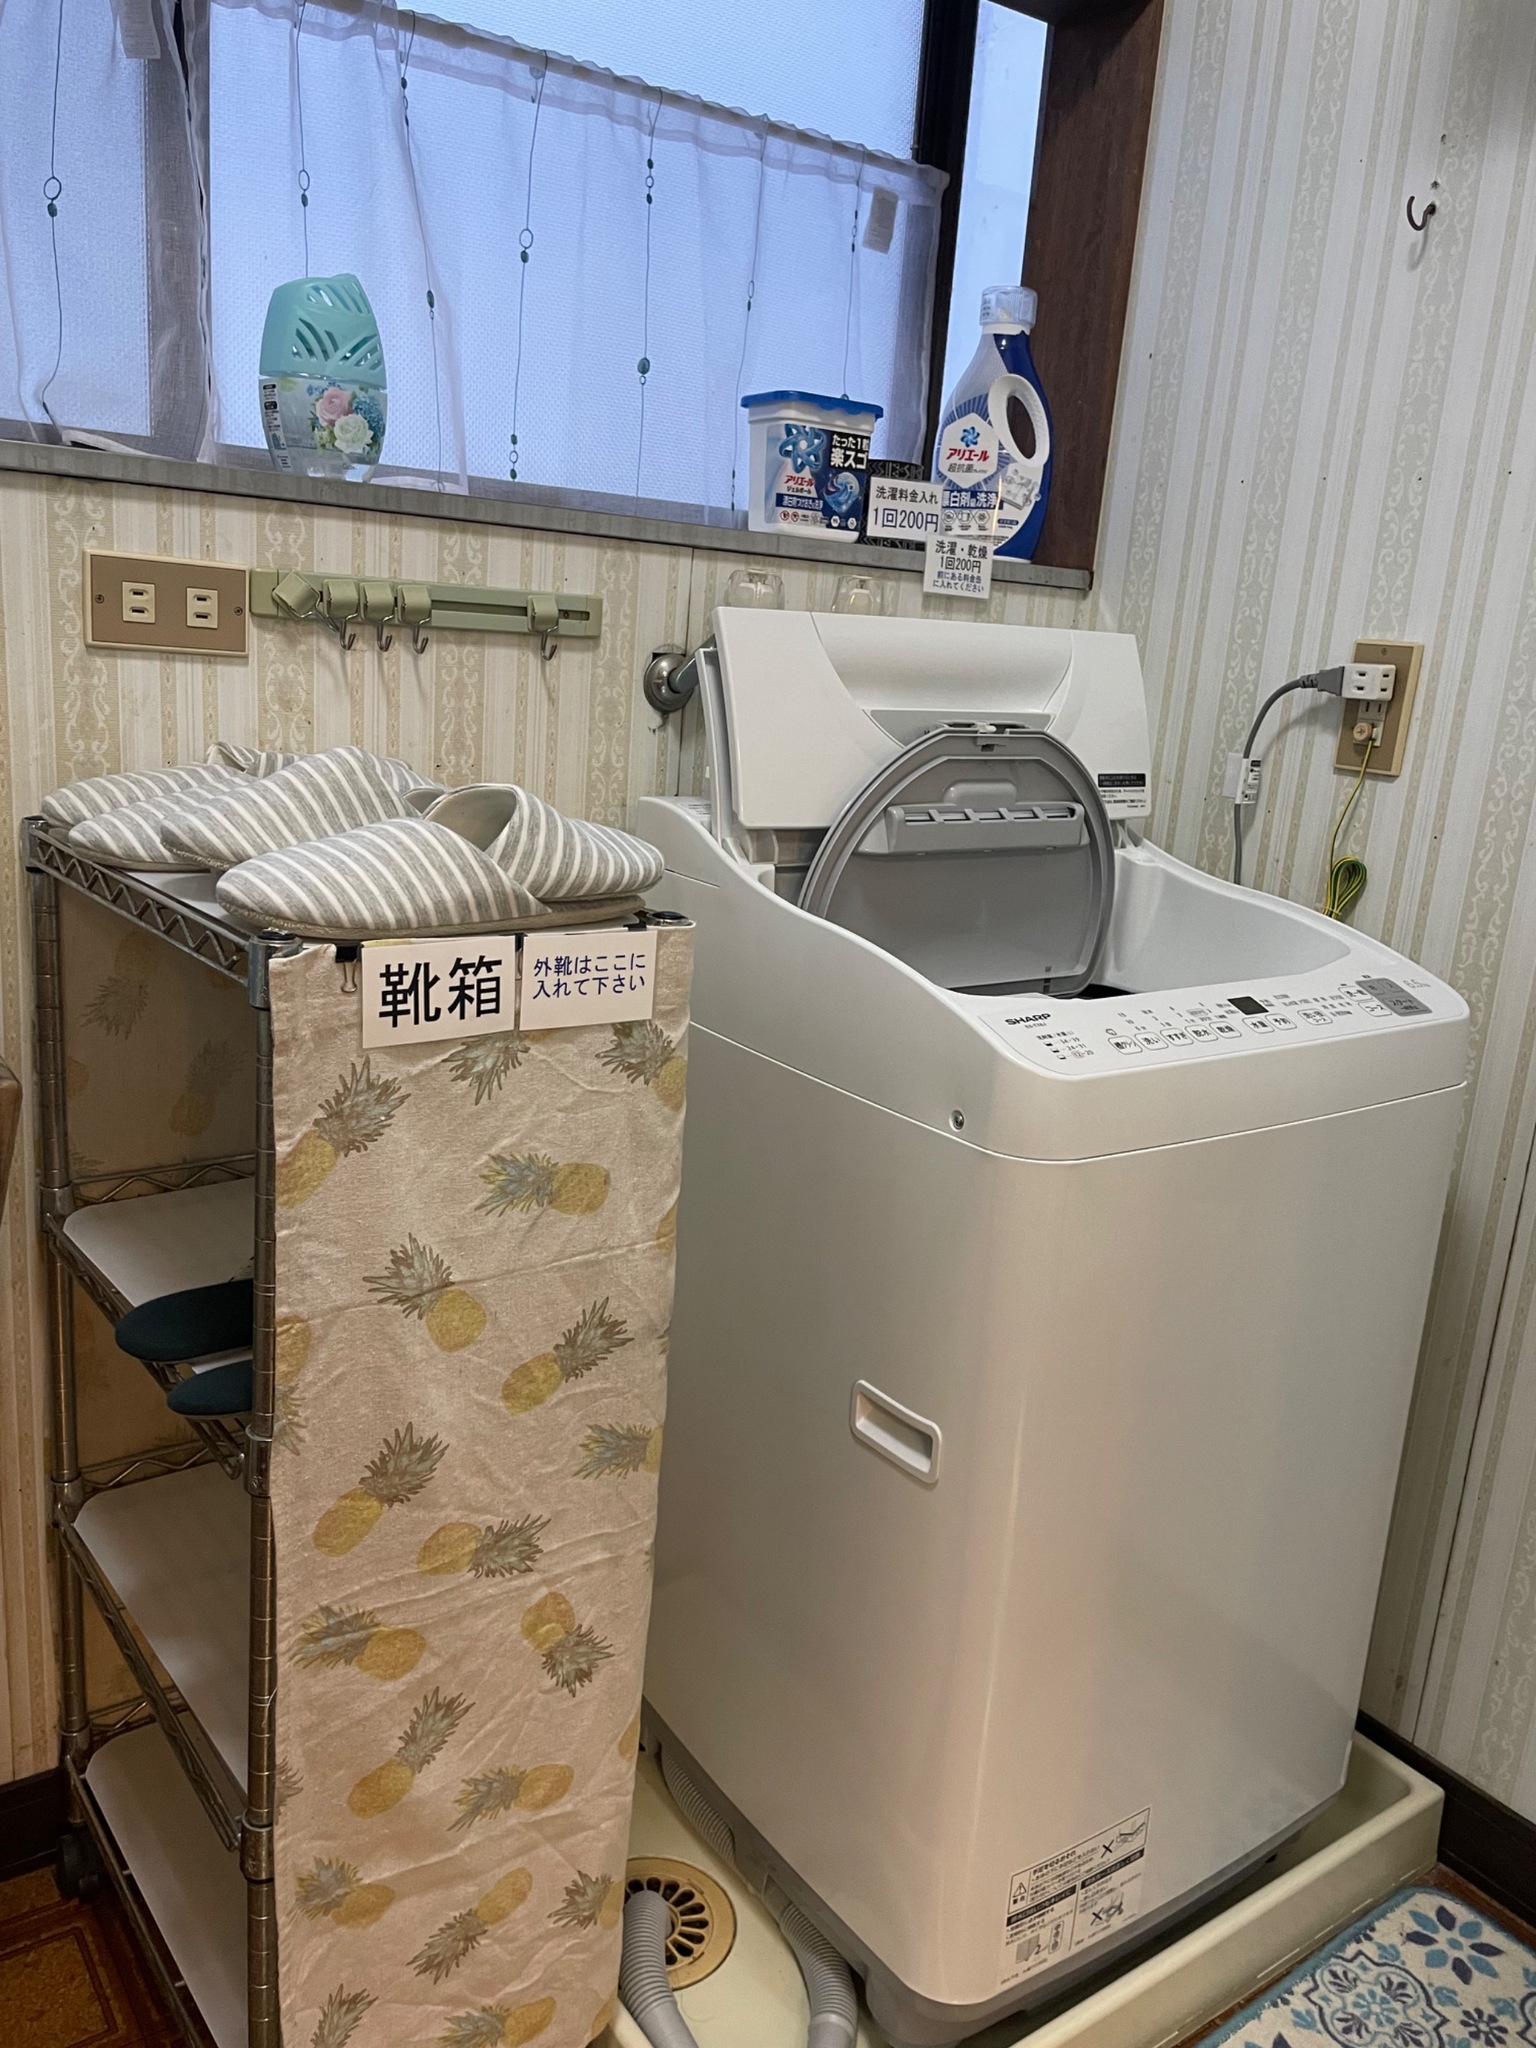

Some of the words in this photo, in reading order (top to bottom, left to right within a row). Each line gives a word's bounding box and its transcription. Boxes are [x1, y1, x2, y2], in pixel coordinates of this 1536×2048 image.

[946, 448, 989, 462] アリエール
[784, 474, 815, 487] アリエール
[876, 485, 938, 505] 洗濯料金入れ
[873, 507, 939, 533] 1回200円
[935, 540, 988, 559] 洗濯・乾燥
[940, 556, 981, 573] 1回200円
[933, 580, 984, 593] に入れてください
[533, 952, 646, 977] 外靴はここに
[378, 955, 502, 1028] 靴箱
[532, 974, 646, 1000] 入れて下さい
[1005, 1013, 1051, 1026] SHARP
